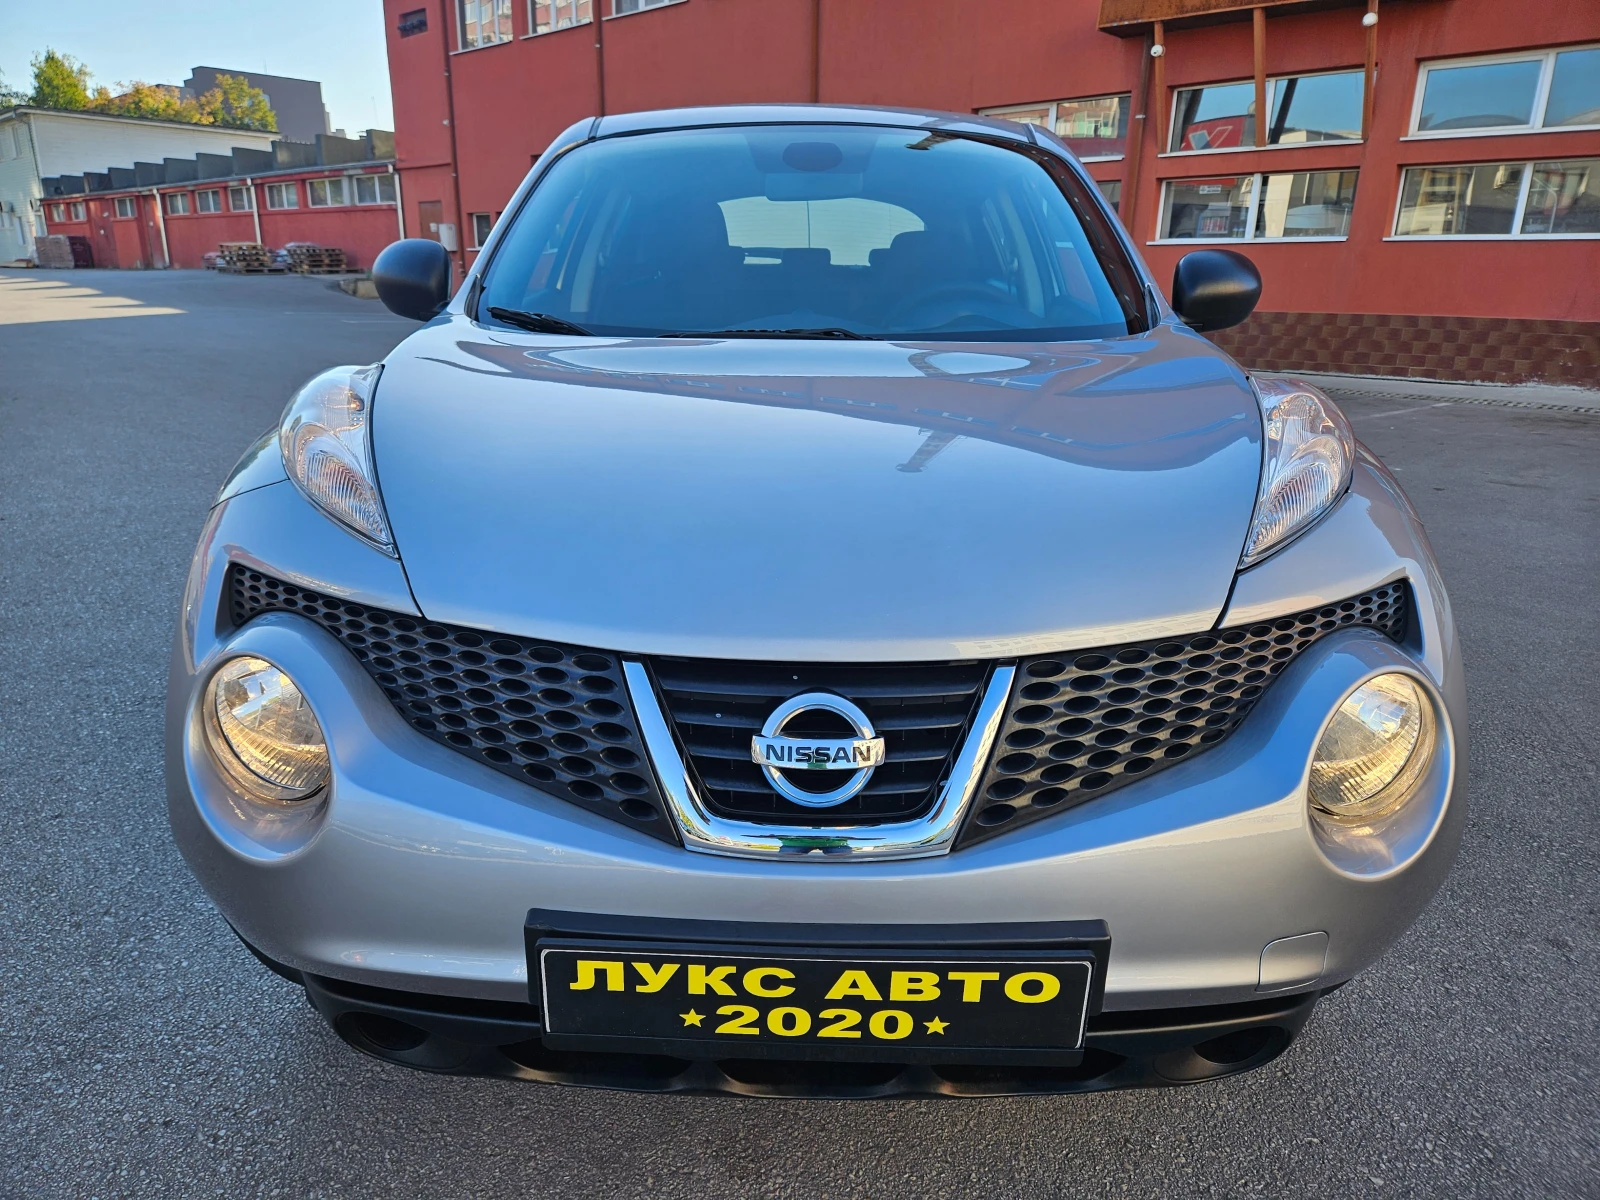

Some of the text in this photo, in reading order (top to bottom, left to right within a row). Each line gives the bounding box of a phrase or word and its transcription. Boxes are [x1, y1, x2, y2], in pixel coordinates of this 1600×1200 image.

[765, 744, 871, 764] NISSAN
[569, 960, 1061, 1004] ЛУКС АВТО
[714, 1004, 914, 1040] 2020
